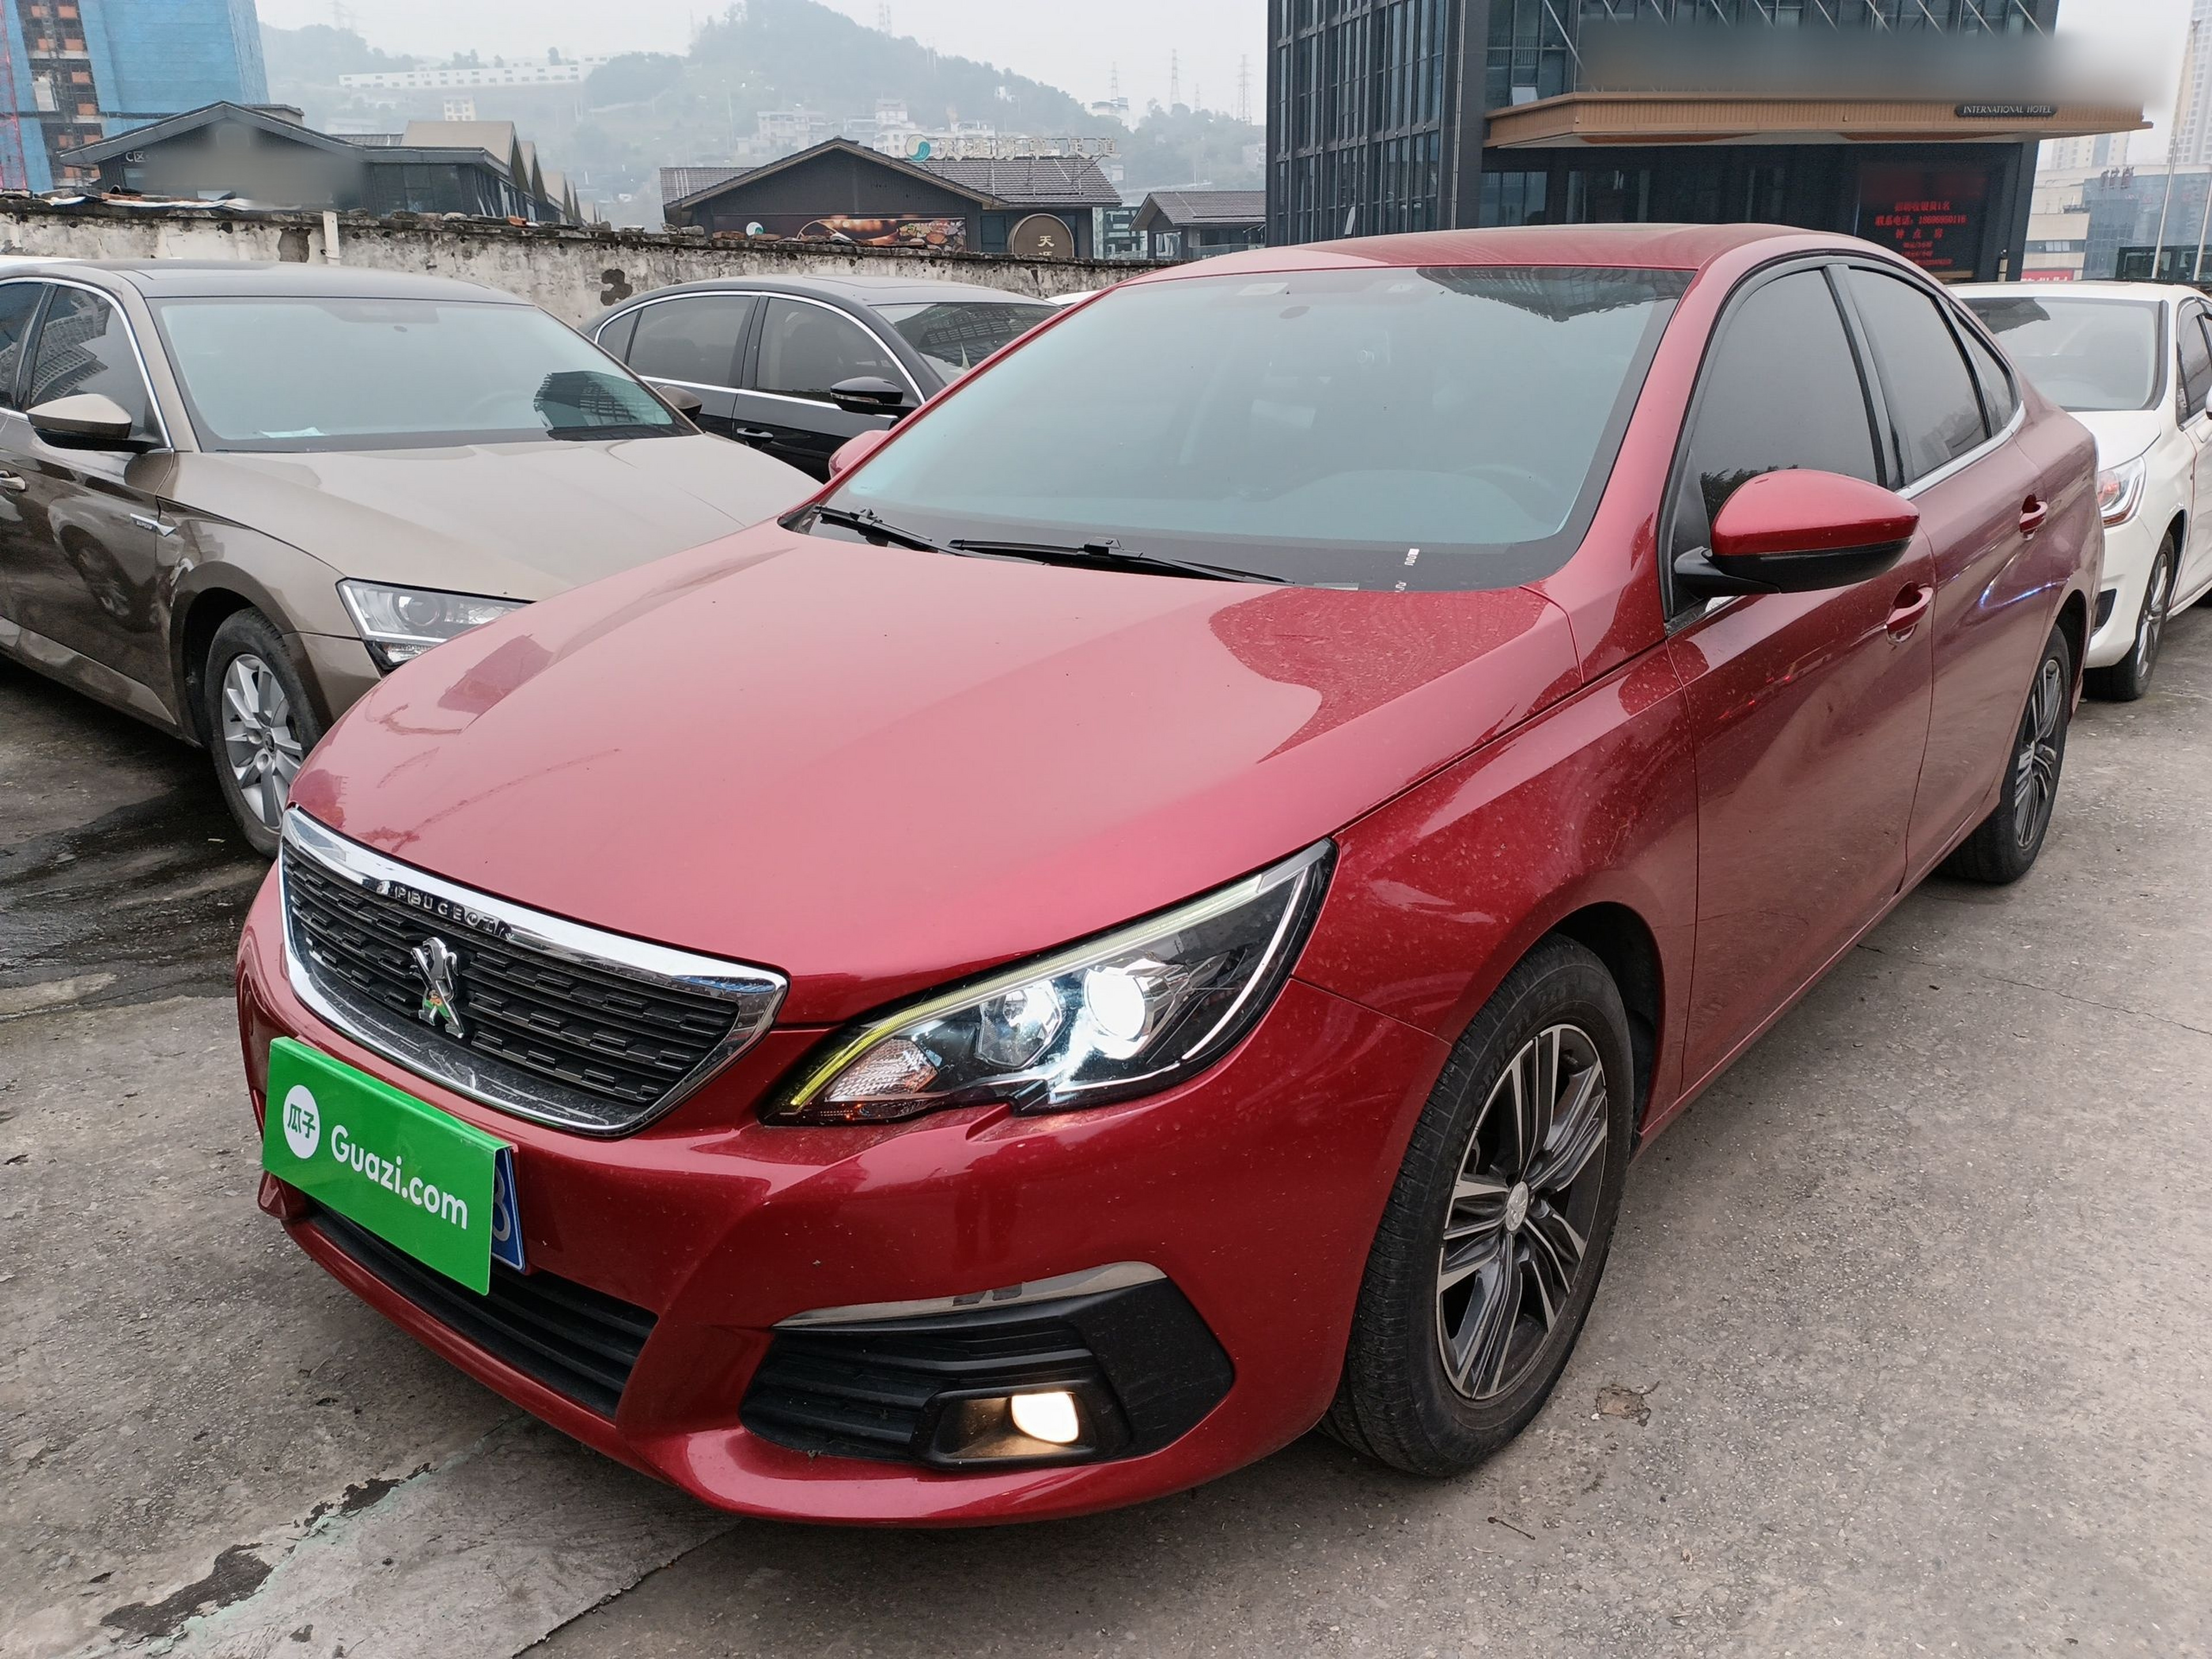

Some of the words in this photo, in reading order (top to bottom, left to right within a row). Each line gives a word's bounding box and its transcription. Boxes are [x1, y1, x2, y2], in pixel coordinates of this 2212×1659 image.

[1963, 105, 2024, 114] INTERNATIONAL
[2027, 105, 2052, 113] HOTEL
[394, 885, 497, 934] PEUGEOT
[287, 1103, 316, 1139] 瓜子
[331, 1124, 468, 1230] Guazi.com
